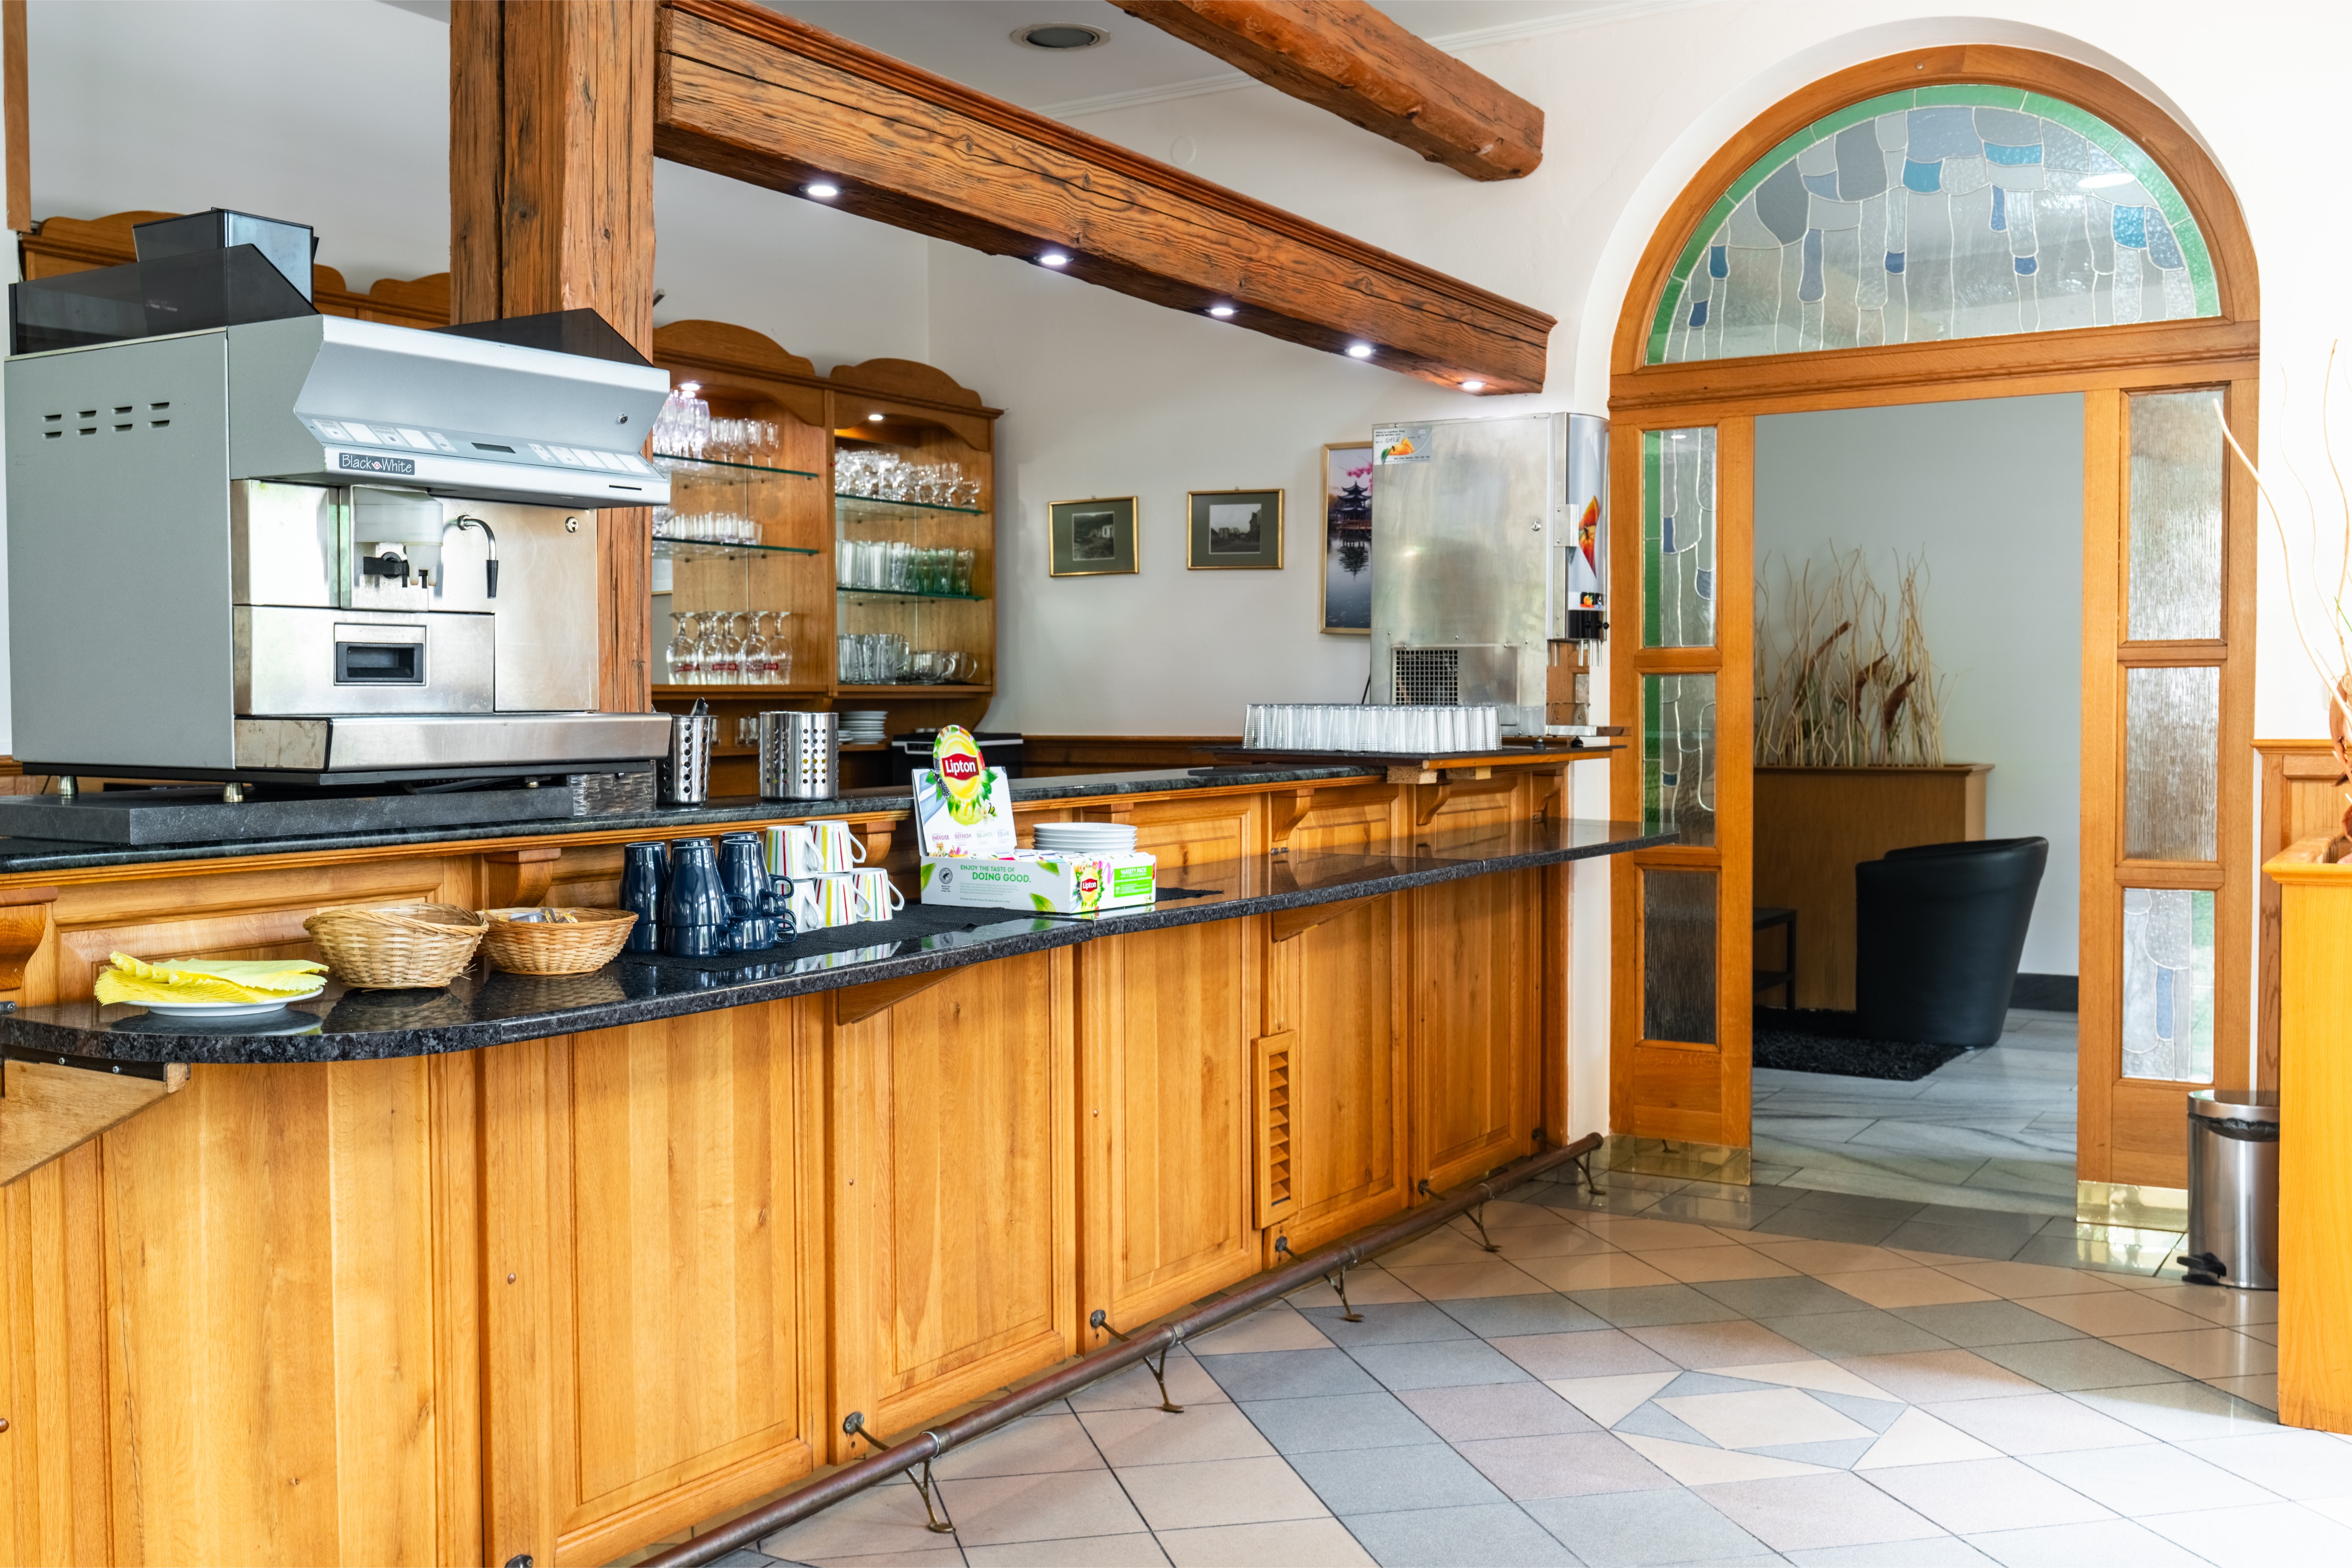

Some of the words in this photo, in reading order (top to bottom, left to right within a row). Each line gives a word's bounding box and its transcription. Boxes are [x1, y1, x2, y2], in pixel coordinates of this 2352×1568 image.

[342, 454, 372, 470] Black
[381, 458, 412, 473] White
[944, 759, 976, 776] Lipton
[972, 872, 1001, 881] DOING
[1003, 874, 1031, 882] GOOD.
[1083, 882, 1096, 890] Lipton
